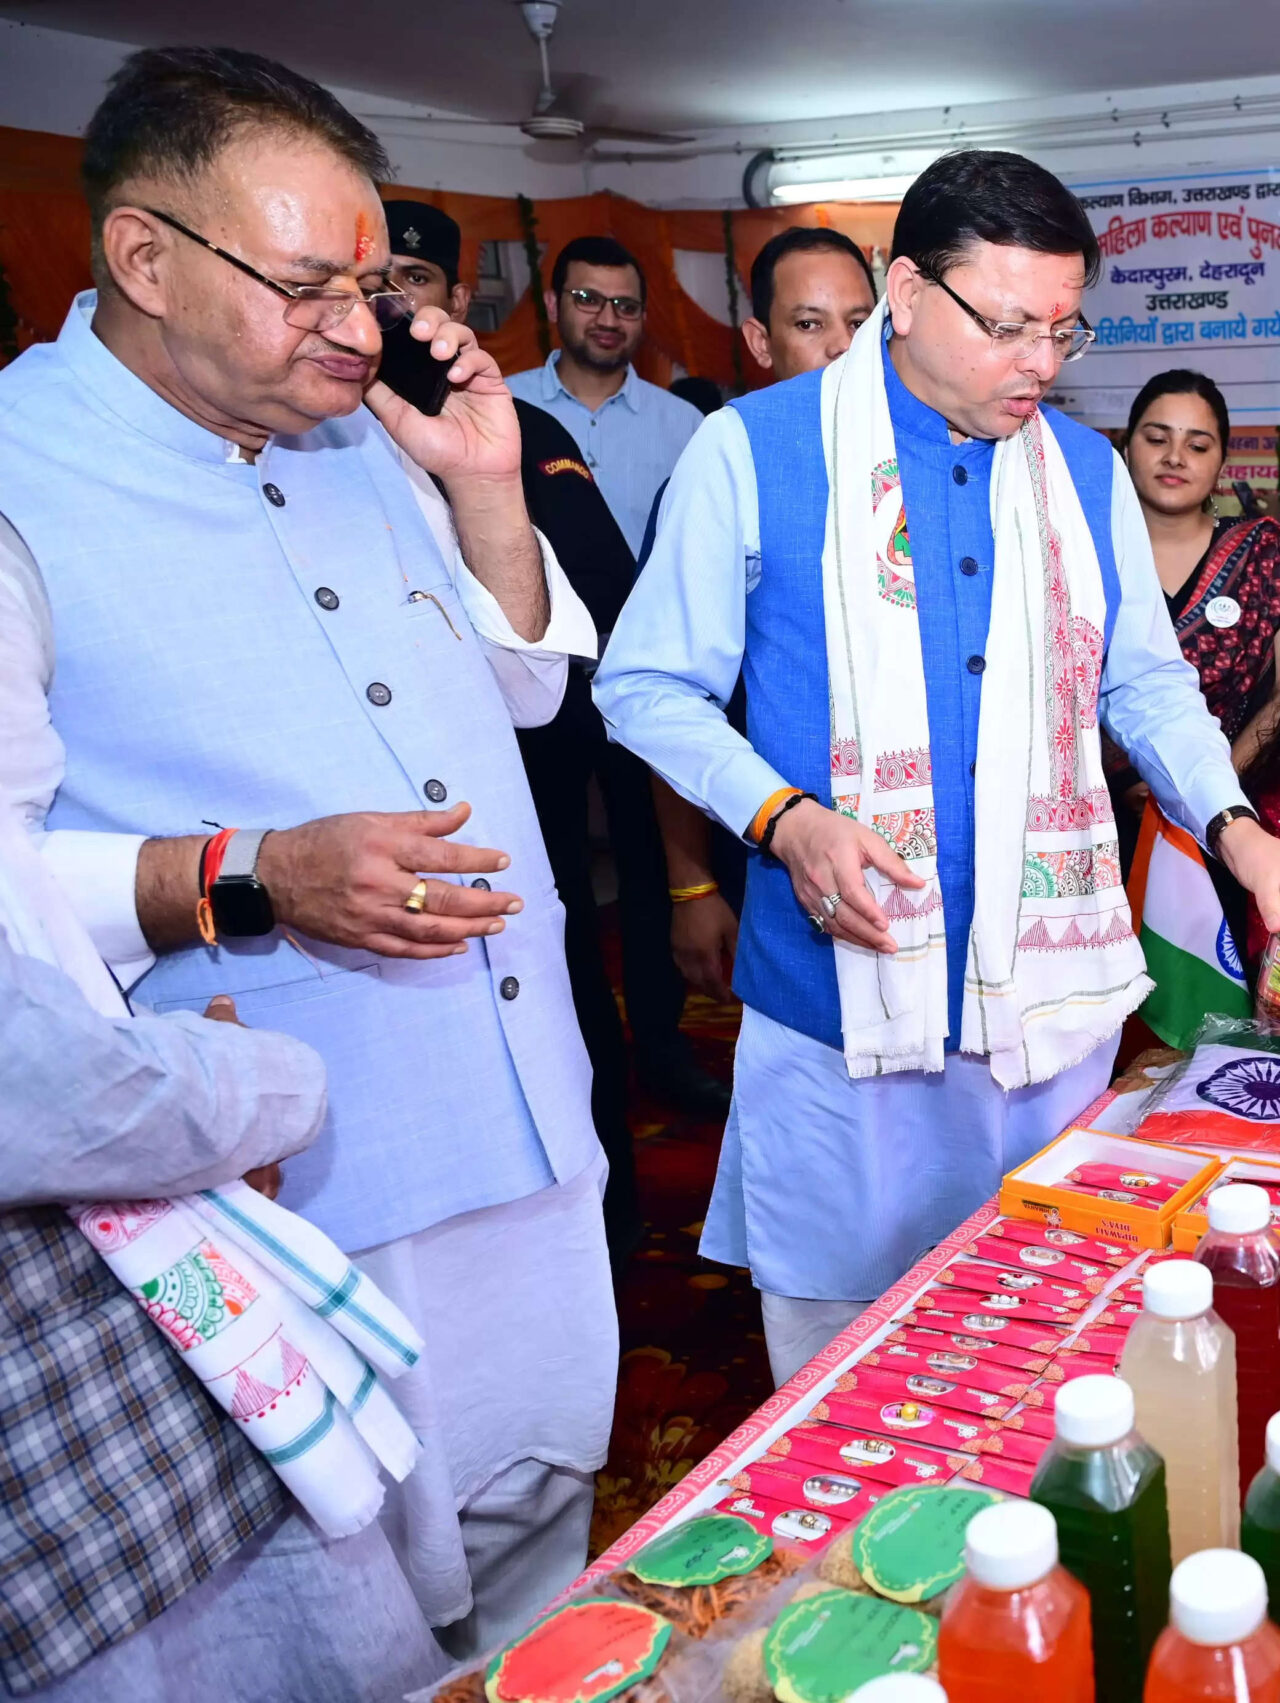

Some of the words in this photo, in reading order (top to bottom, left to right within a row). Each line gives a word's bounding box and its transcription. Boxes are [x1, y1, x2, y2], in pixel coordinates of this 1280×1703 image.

[1151, 211, 1212, 239] कल्याण
[1216, 205, 1244, 240] एवं
[1198, 259, 1266, 285] देहरादून
[1145, 290, 1229, 312] उत्तराखण्ड
[1161, 322, 1195, 345] द्वारा
[1199, 311, 1247, 341] बनाये
